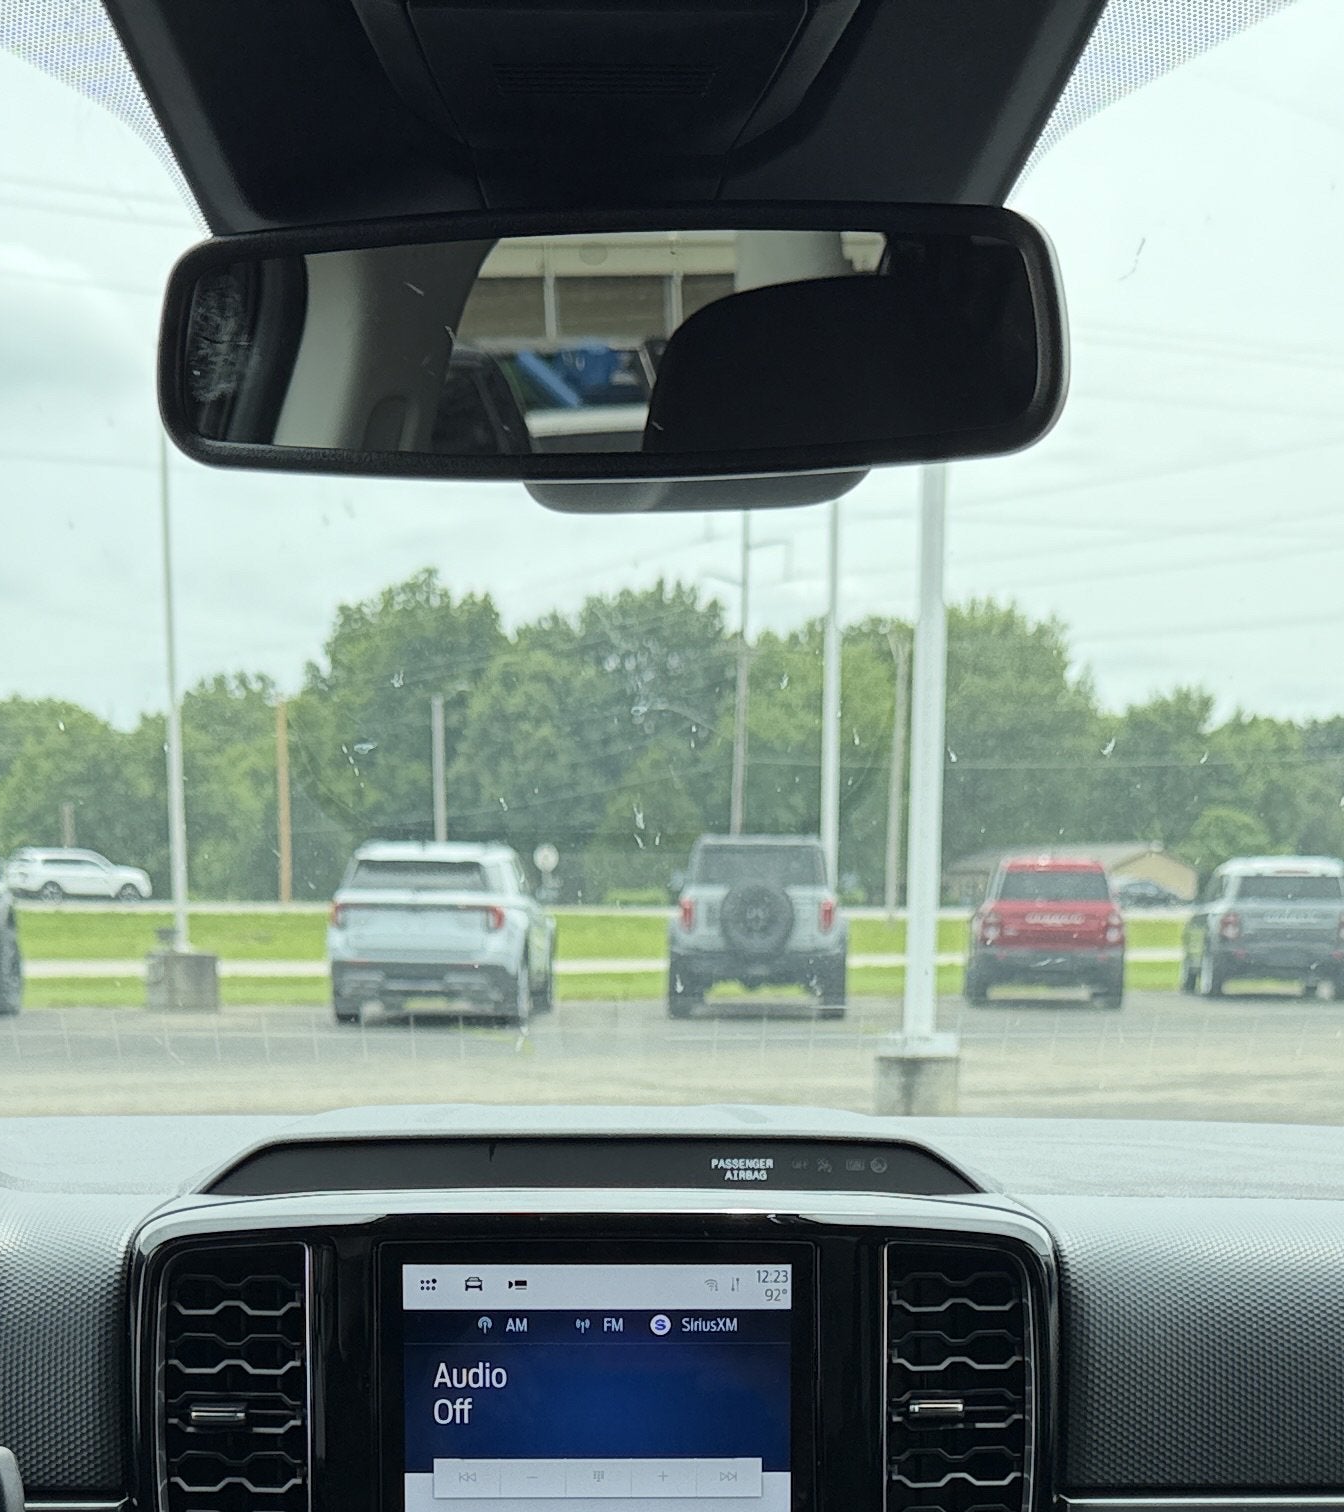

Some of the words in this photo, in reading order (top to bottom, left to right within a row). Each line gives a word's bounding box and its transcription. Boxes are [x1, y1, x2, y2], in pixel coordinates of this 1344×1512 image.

[711, 1158, 774, 1169] PASSENGER
[724, 1169, 768, 1181] AIRBAG
[756, 1269, 789, 1284] 12:23
[505, 1318, 528, 1333] AM
[603, 1318, 624, 1333] FM
[681, 1317, 738, 1333] SiriusXM
[434, 1363, 508, 1389] Audio
[434, 1398, 473, 1425] Off
